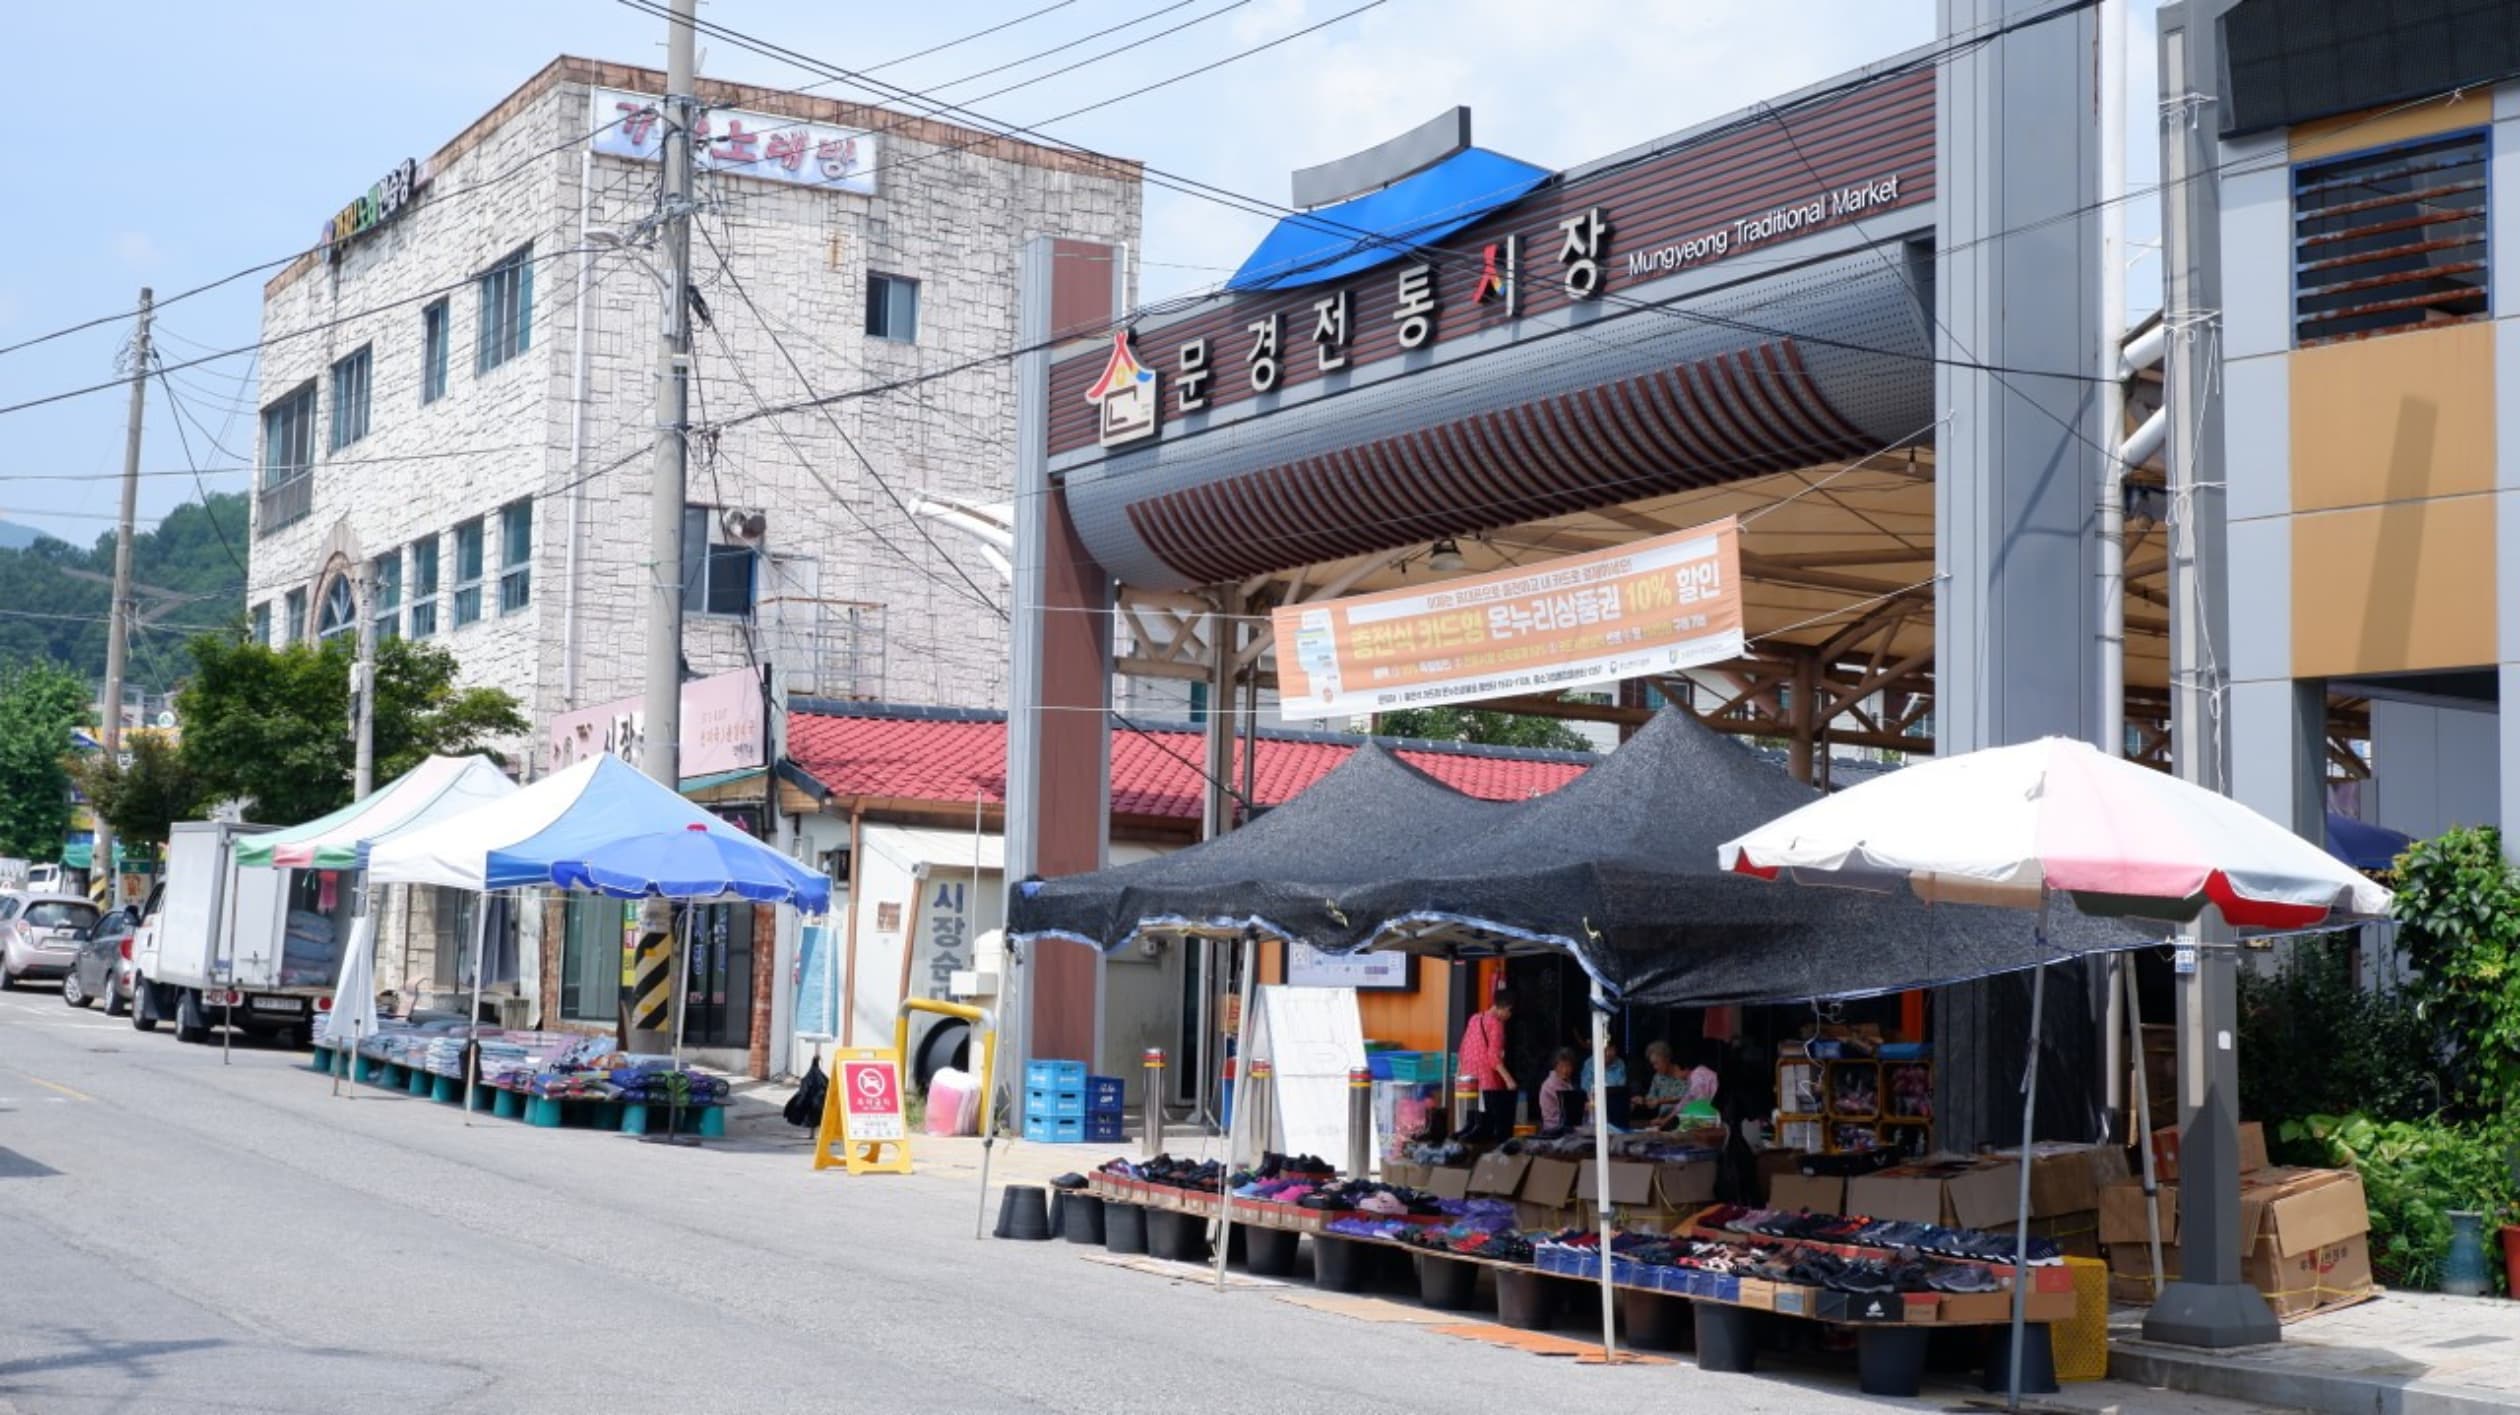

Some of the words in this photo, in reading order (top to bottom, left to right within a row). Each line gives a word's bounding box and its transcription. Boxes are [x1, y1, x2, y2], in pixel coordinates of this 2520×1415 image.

[1629, 231, 1728, 277] Mungyeong
[1734, 195, 1827, 246] Traditional
[1832, 174, 1899, 215] Market
[1175, 207, 1607, 412] 문경전통시장
[1351, 622, 1416, 661] 충전식
[1417, 609, 1485, 653] 카드형
[1487, 584, 1622, 640] 온누리상품권
[1625, 575, 1672, 613] 10%
[1676, 560, 1721, 605] 할인
